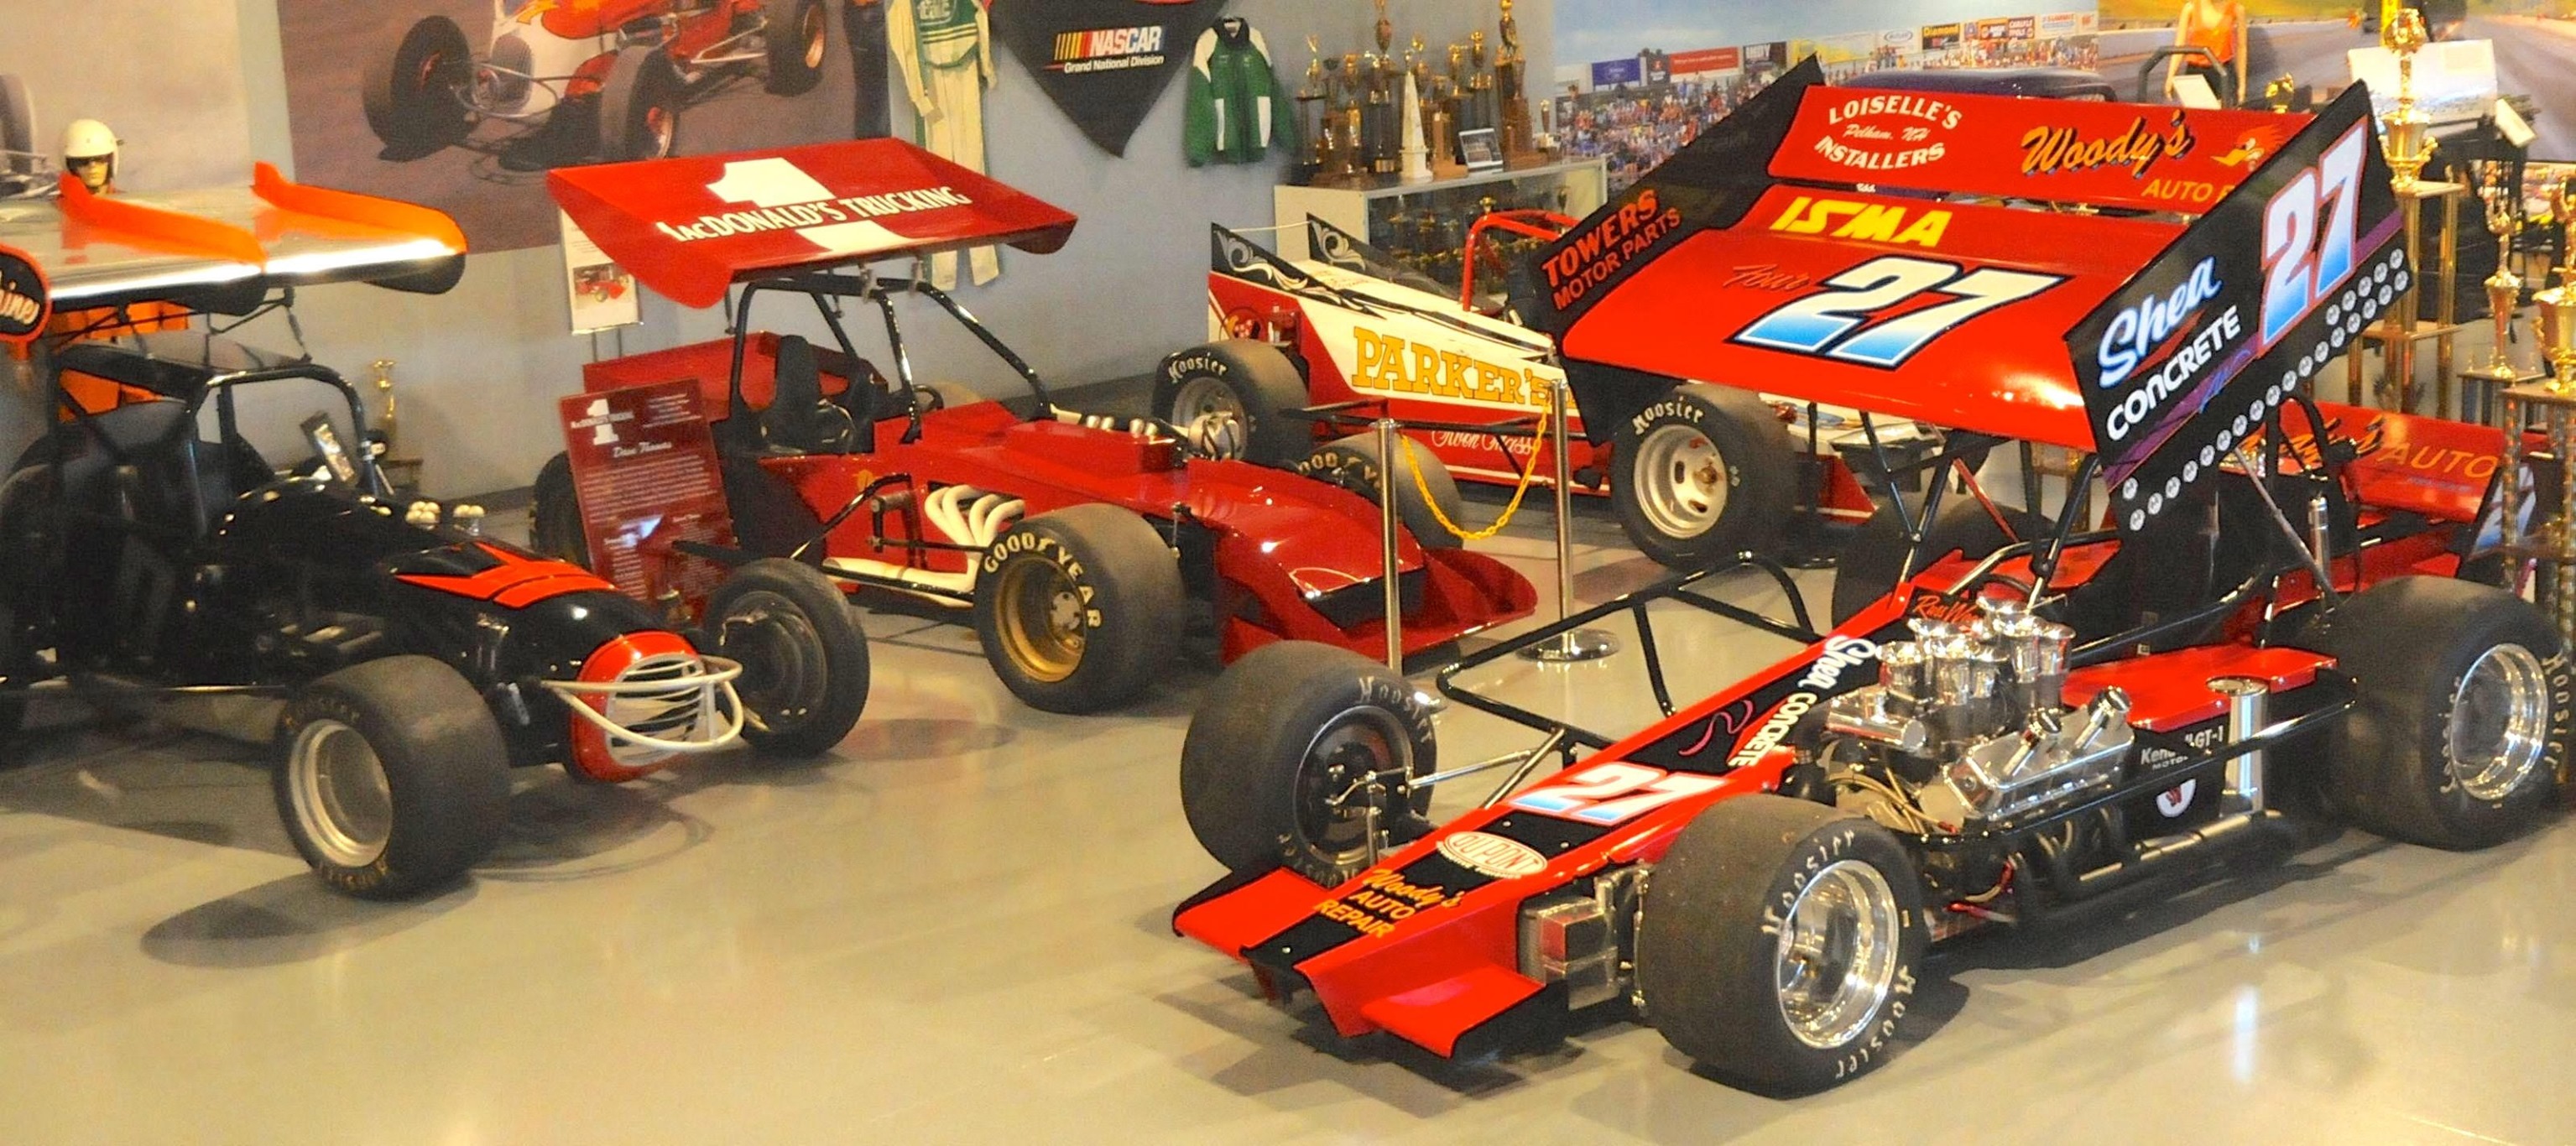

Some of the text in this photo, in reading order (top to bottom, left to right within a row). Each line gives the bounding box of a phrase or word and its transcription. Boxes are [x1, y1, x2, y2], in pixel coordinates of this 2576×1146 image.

[1090, 26, 1162, 57] NASCAR
[1064, 55, 1165, 74] Grand National Division
[1829, 95, 1963, 130] LOISELLE'S
[1814, 135, 1946, 169] INSTALLERS
[2021, 108, 2195, 179] Woody's
[839, 186, 973, 220] TRUCKING
[2141, 179, 2214, 202] AUTO
[1541, 190, 1658, 288] TOWERS
[1769, 196, 1953, 247] ISMA
[2257, 114, 2369, 352] 27
[1553, 207, 1681, 310] MOTOR PARTS
[1724, 254, 2074, 372] 27
[2098, 256, 2223, 388] Shea
[1168, 352, 1228, 383] Hoosier
[1632, 395, 1704, 435] Hoosier
[2376, 442, 2500, 478] AUTO
[983, 532, 1102, 628] GOODYEAR
[1797, 635, 1877, 689] Shea
[1508, 761, 1734, 826] 27
[1348, 890, 1416, 919] AUTO
[1363, 868, 1465, 909] Woody's
[1313, 899, 1395, 939] REPAIR
